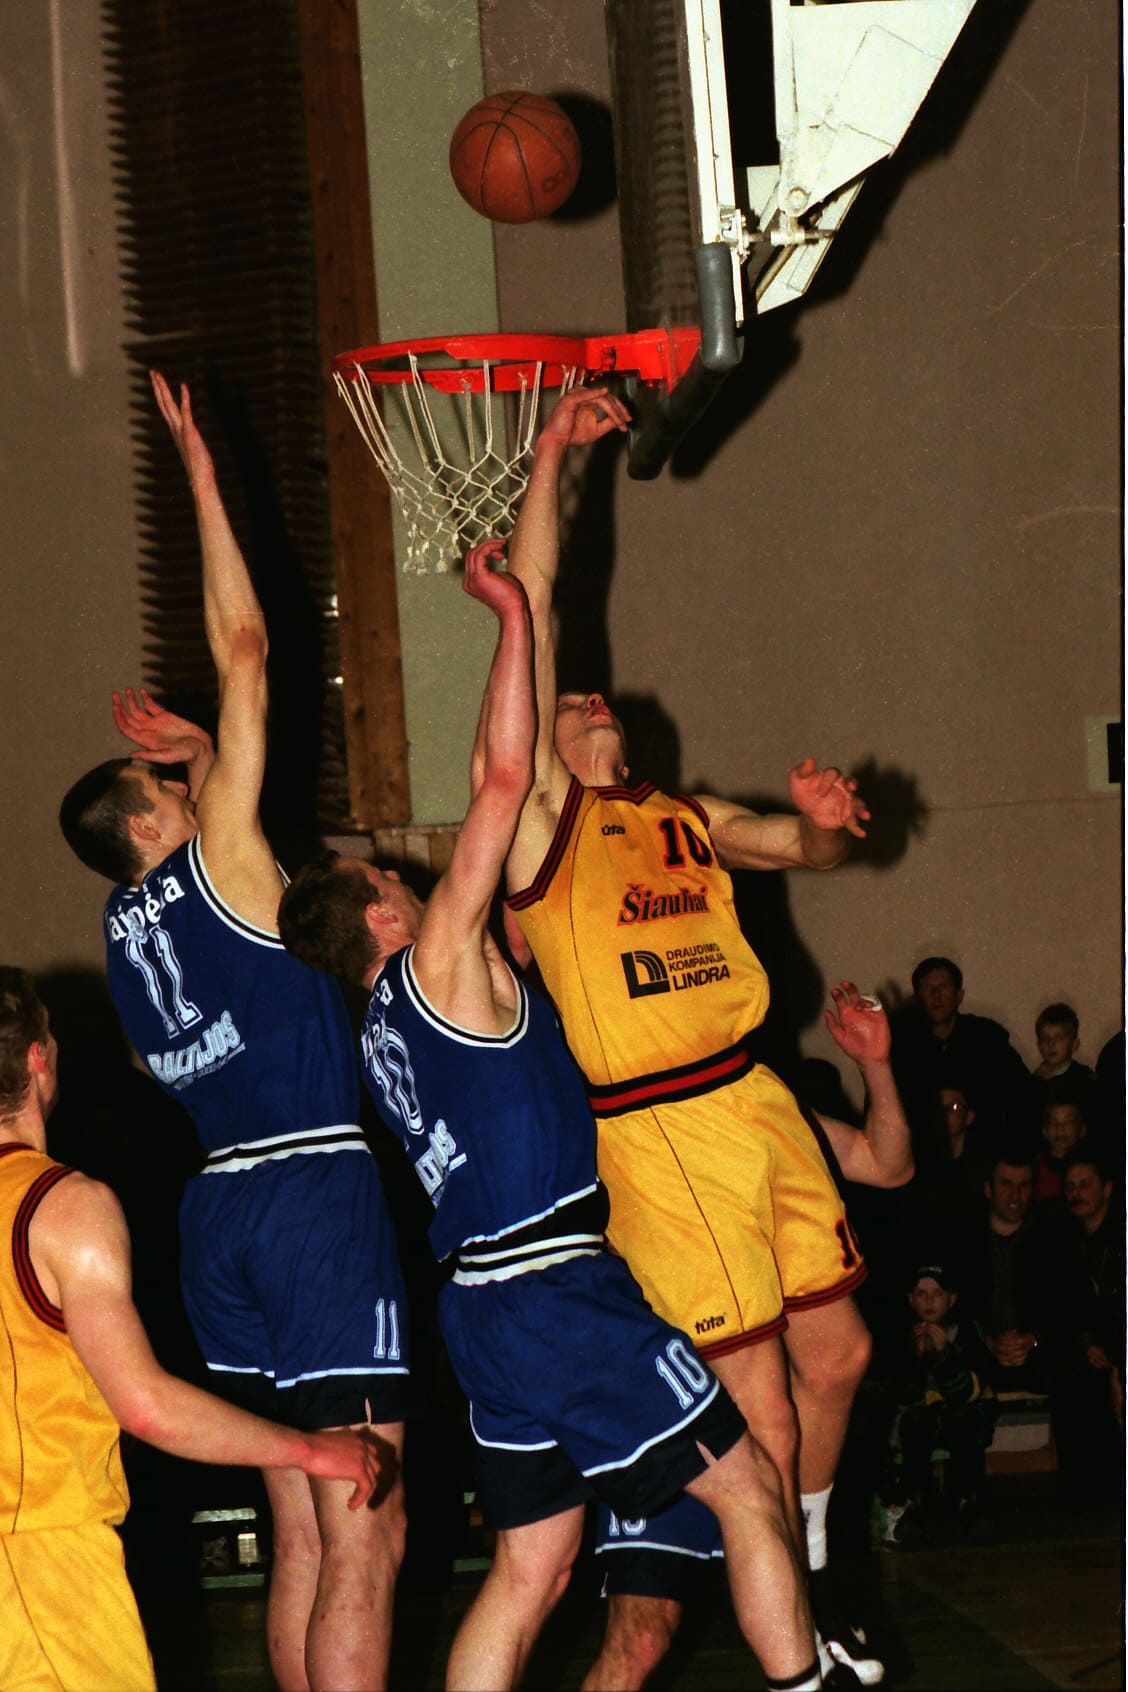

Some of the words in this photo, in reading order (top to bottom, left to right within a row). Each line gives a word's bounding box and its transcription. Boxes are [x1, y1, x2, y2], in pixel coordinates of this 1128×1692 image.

[125, 922, 203, 1040] 11
[672, 964, 731, 991] LINDRA
[373, 1298, 401, 1361] 11
[655, 1338, 709, 1410] 10
